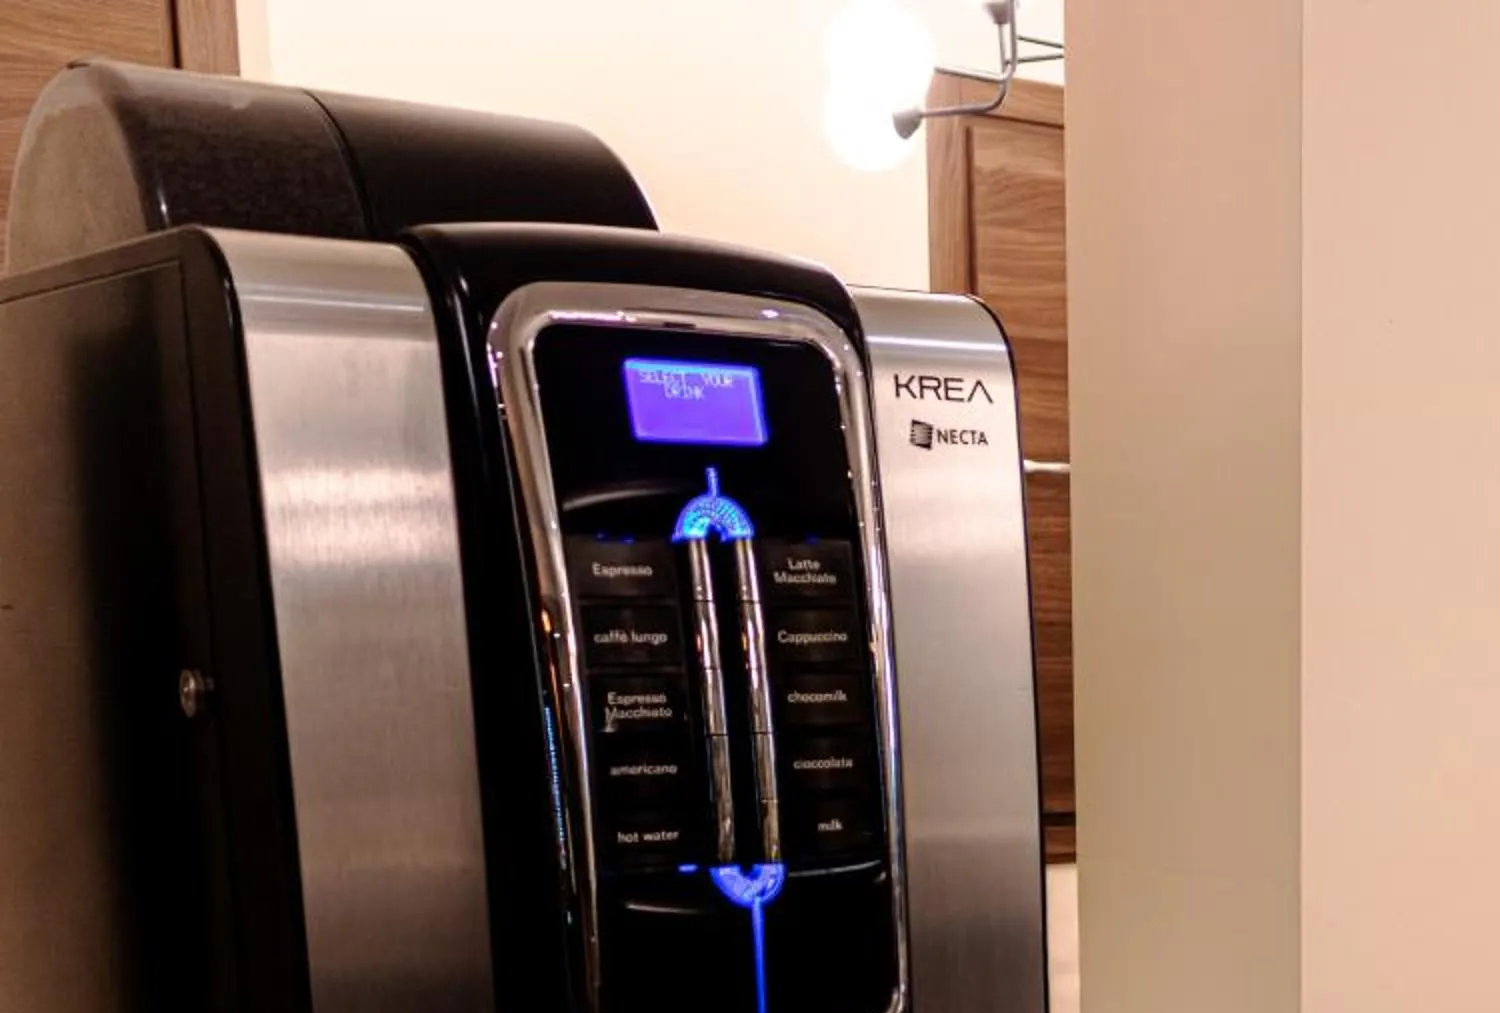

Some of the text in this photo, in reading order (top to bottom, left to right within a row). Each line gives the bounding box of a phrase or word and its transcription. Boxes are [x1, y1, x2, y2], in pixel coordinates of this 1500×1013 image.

[639, 369, 733, 388] SELECT YOUR
[893, 373, 994, 405] KREA
[936, 428, 989, 446] NECTA
[592, 562, 653, 578] Espresso
[787, 558, 820, 571] Latte
[774, 571, 837, 585] Macchiato
[631, 631, 669, 645] lungo
[778, 630, 848, 645] Cappuccino
[607, 691, 667, 706] Espresso
[788, 689, 848, 703] chocomilk
[605, 706, 673, 720] Macchiato
[609, 764, 678, 777] americano
[817, 819, 844, 832] milk
[617, 829, 680, 844] hot water
